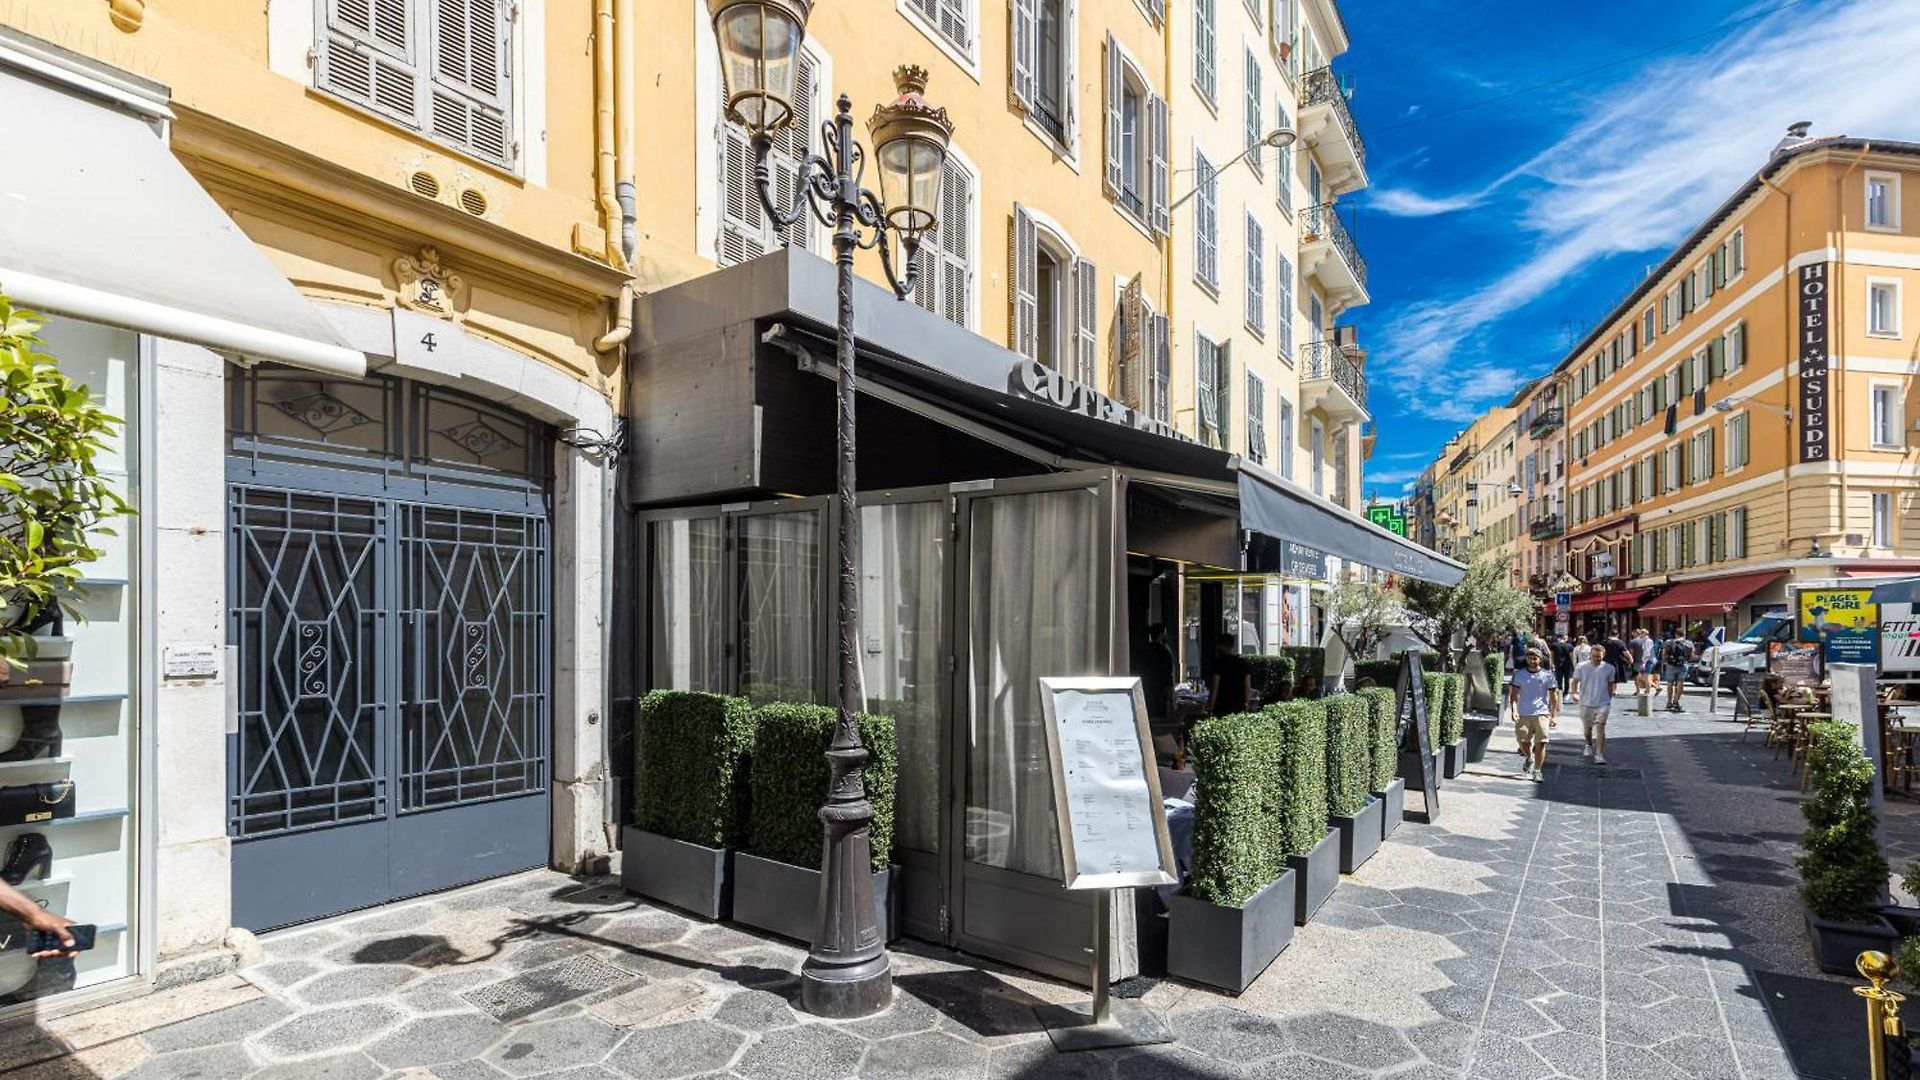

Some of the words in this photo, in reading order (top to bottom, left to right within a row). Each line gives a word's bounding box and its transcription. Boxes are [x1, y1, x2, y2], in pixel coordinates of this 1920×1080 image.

[1803, 265, 1824, 344] HOTEL
[420, 332, 437, 352] 4
[1801, 367, 1827, 379] de
[1806, 380, 1824, 460] SUEDE
[1816, 594, 1858, 602] PLAGES
[1882, 621, 1917, 633] ETIT
